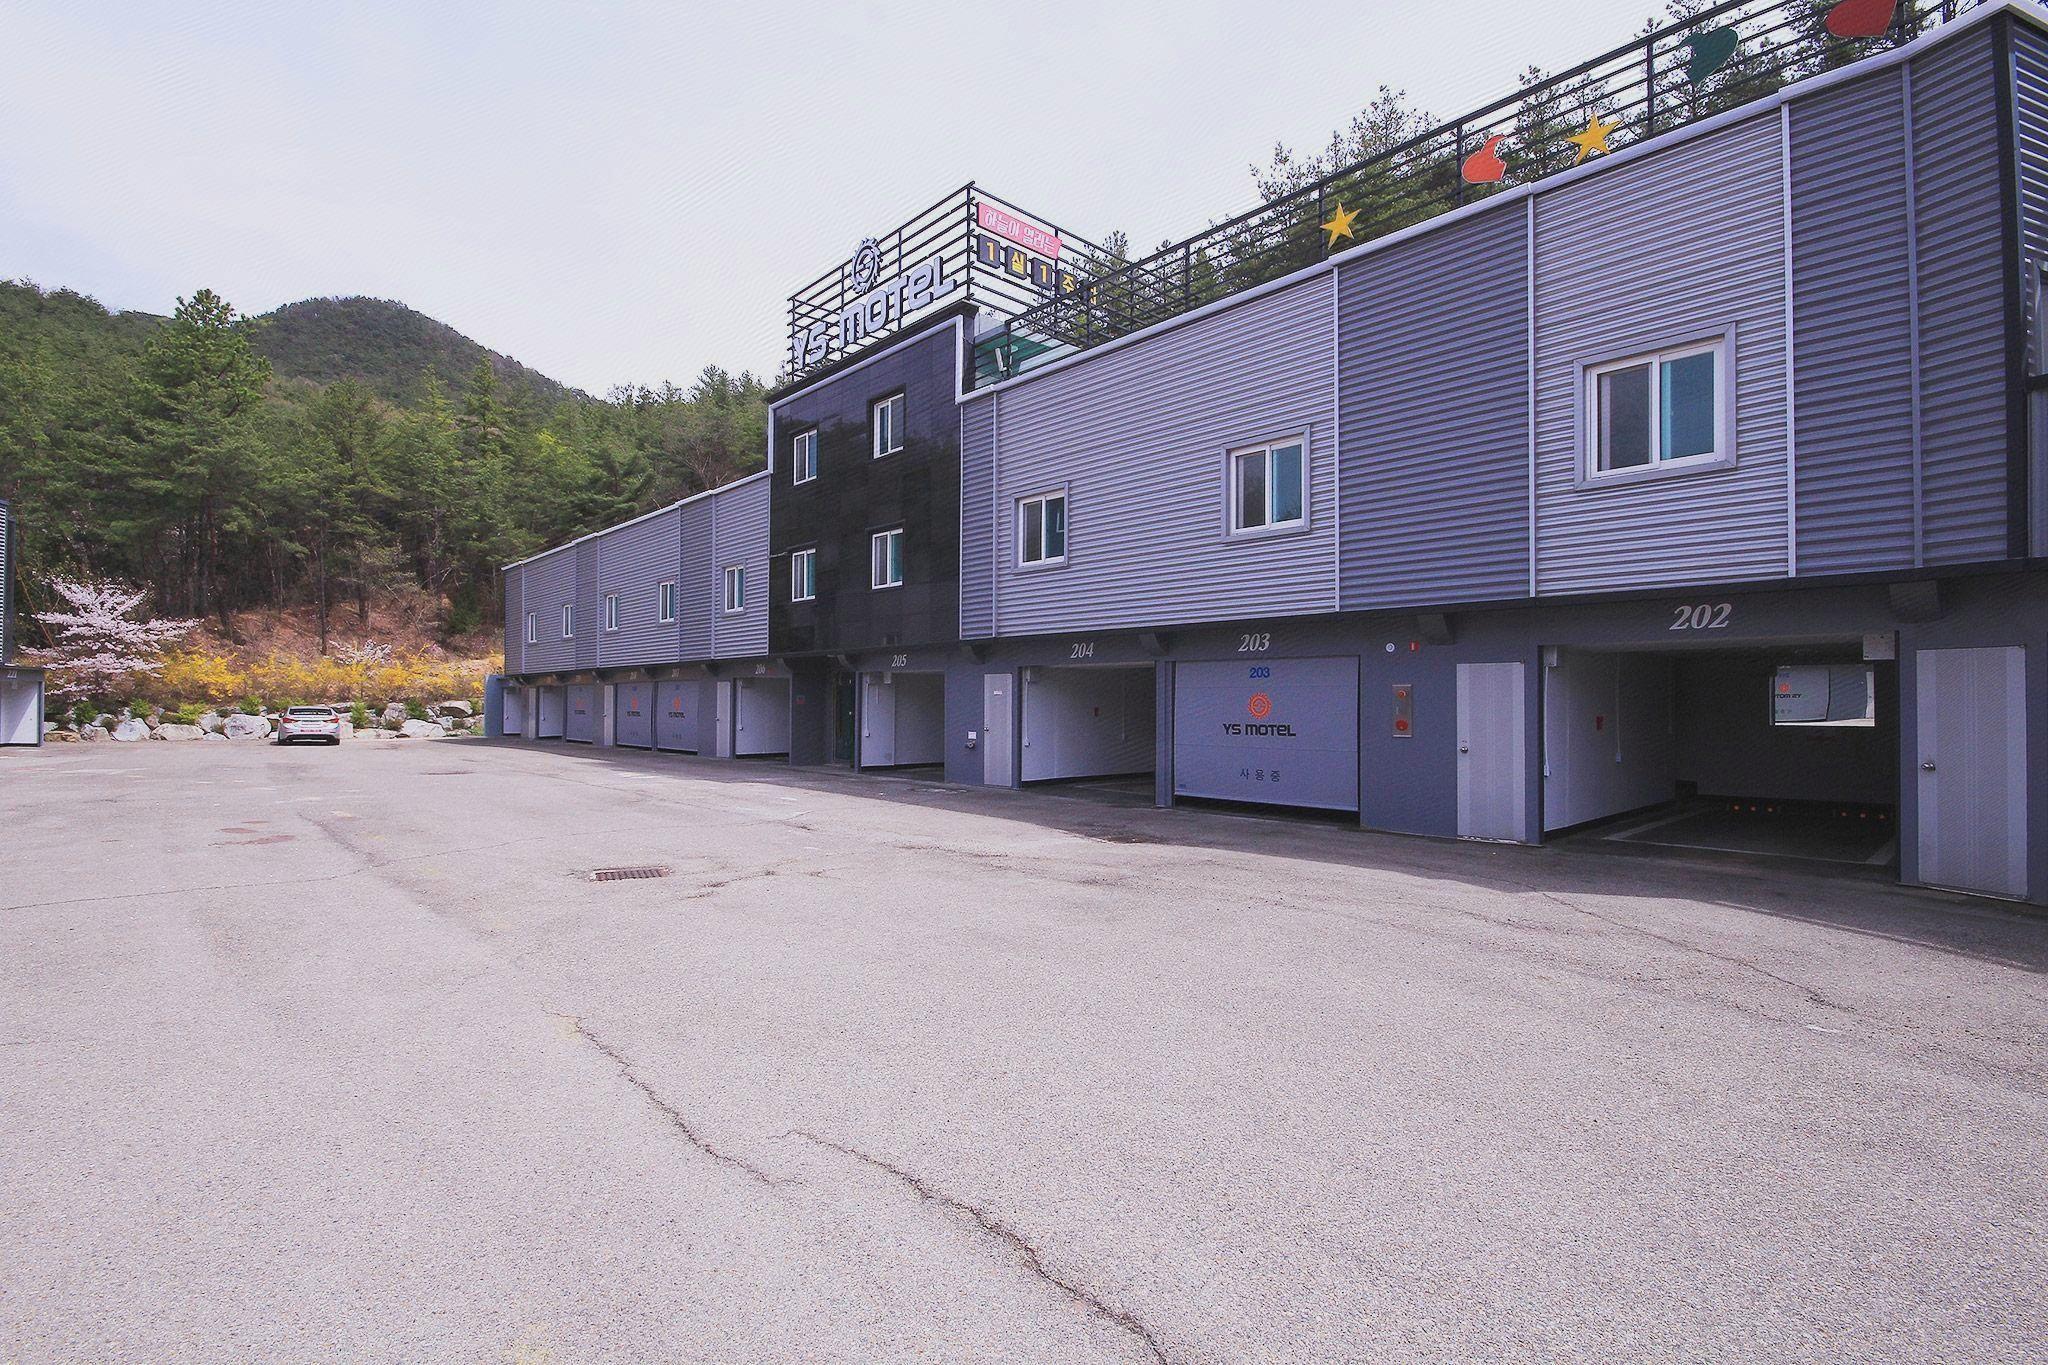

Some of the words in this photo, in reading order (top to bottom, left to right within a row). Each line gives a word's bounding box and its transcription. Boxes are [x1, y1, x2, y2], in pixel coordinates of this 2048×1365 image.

[791, 322, 828, 369] YS
[1668, 603, 1733, 630] 202
[1070, 642, 1095, 659] 204
[1238, 632, 1271, 652] 203
[891, 654, 907, 667] 205
[1249, 667, 1271, 679] 203
[1222, 723, 1241, 736] YS
